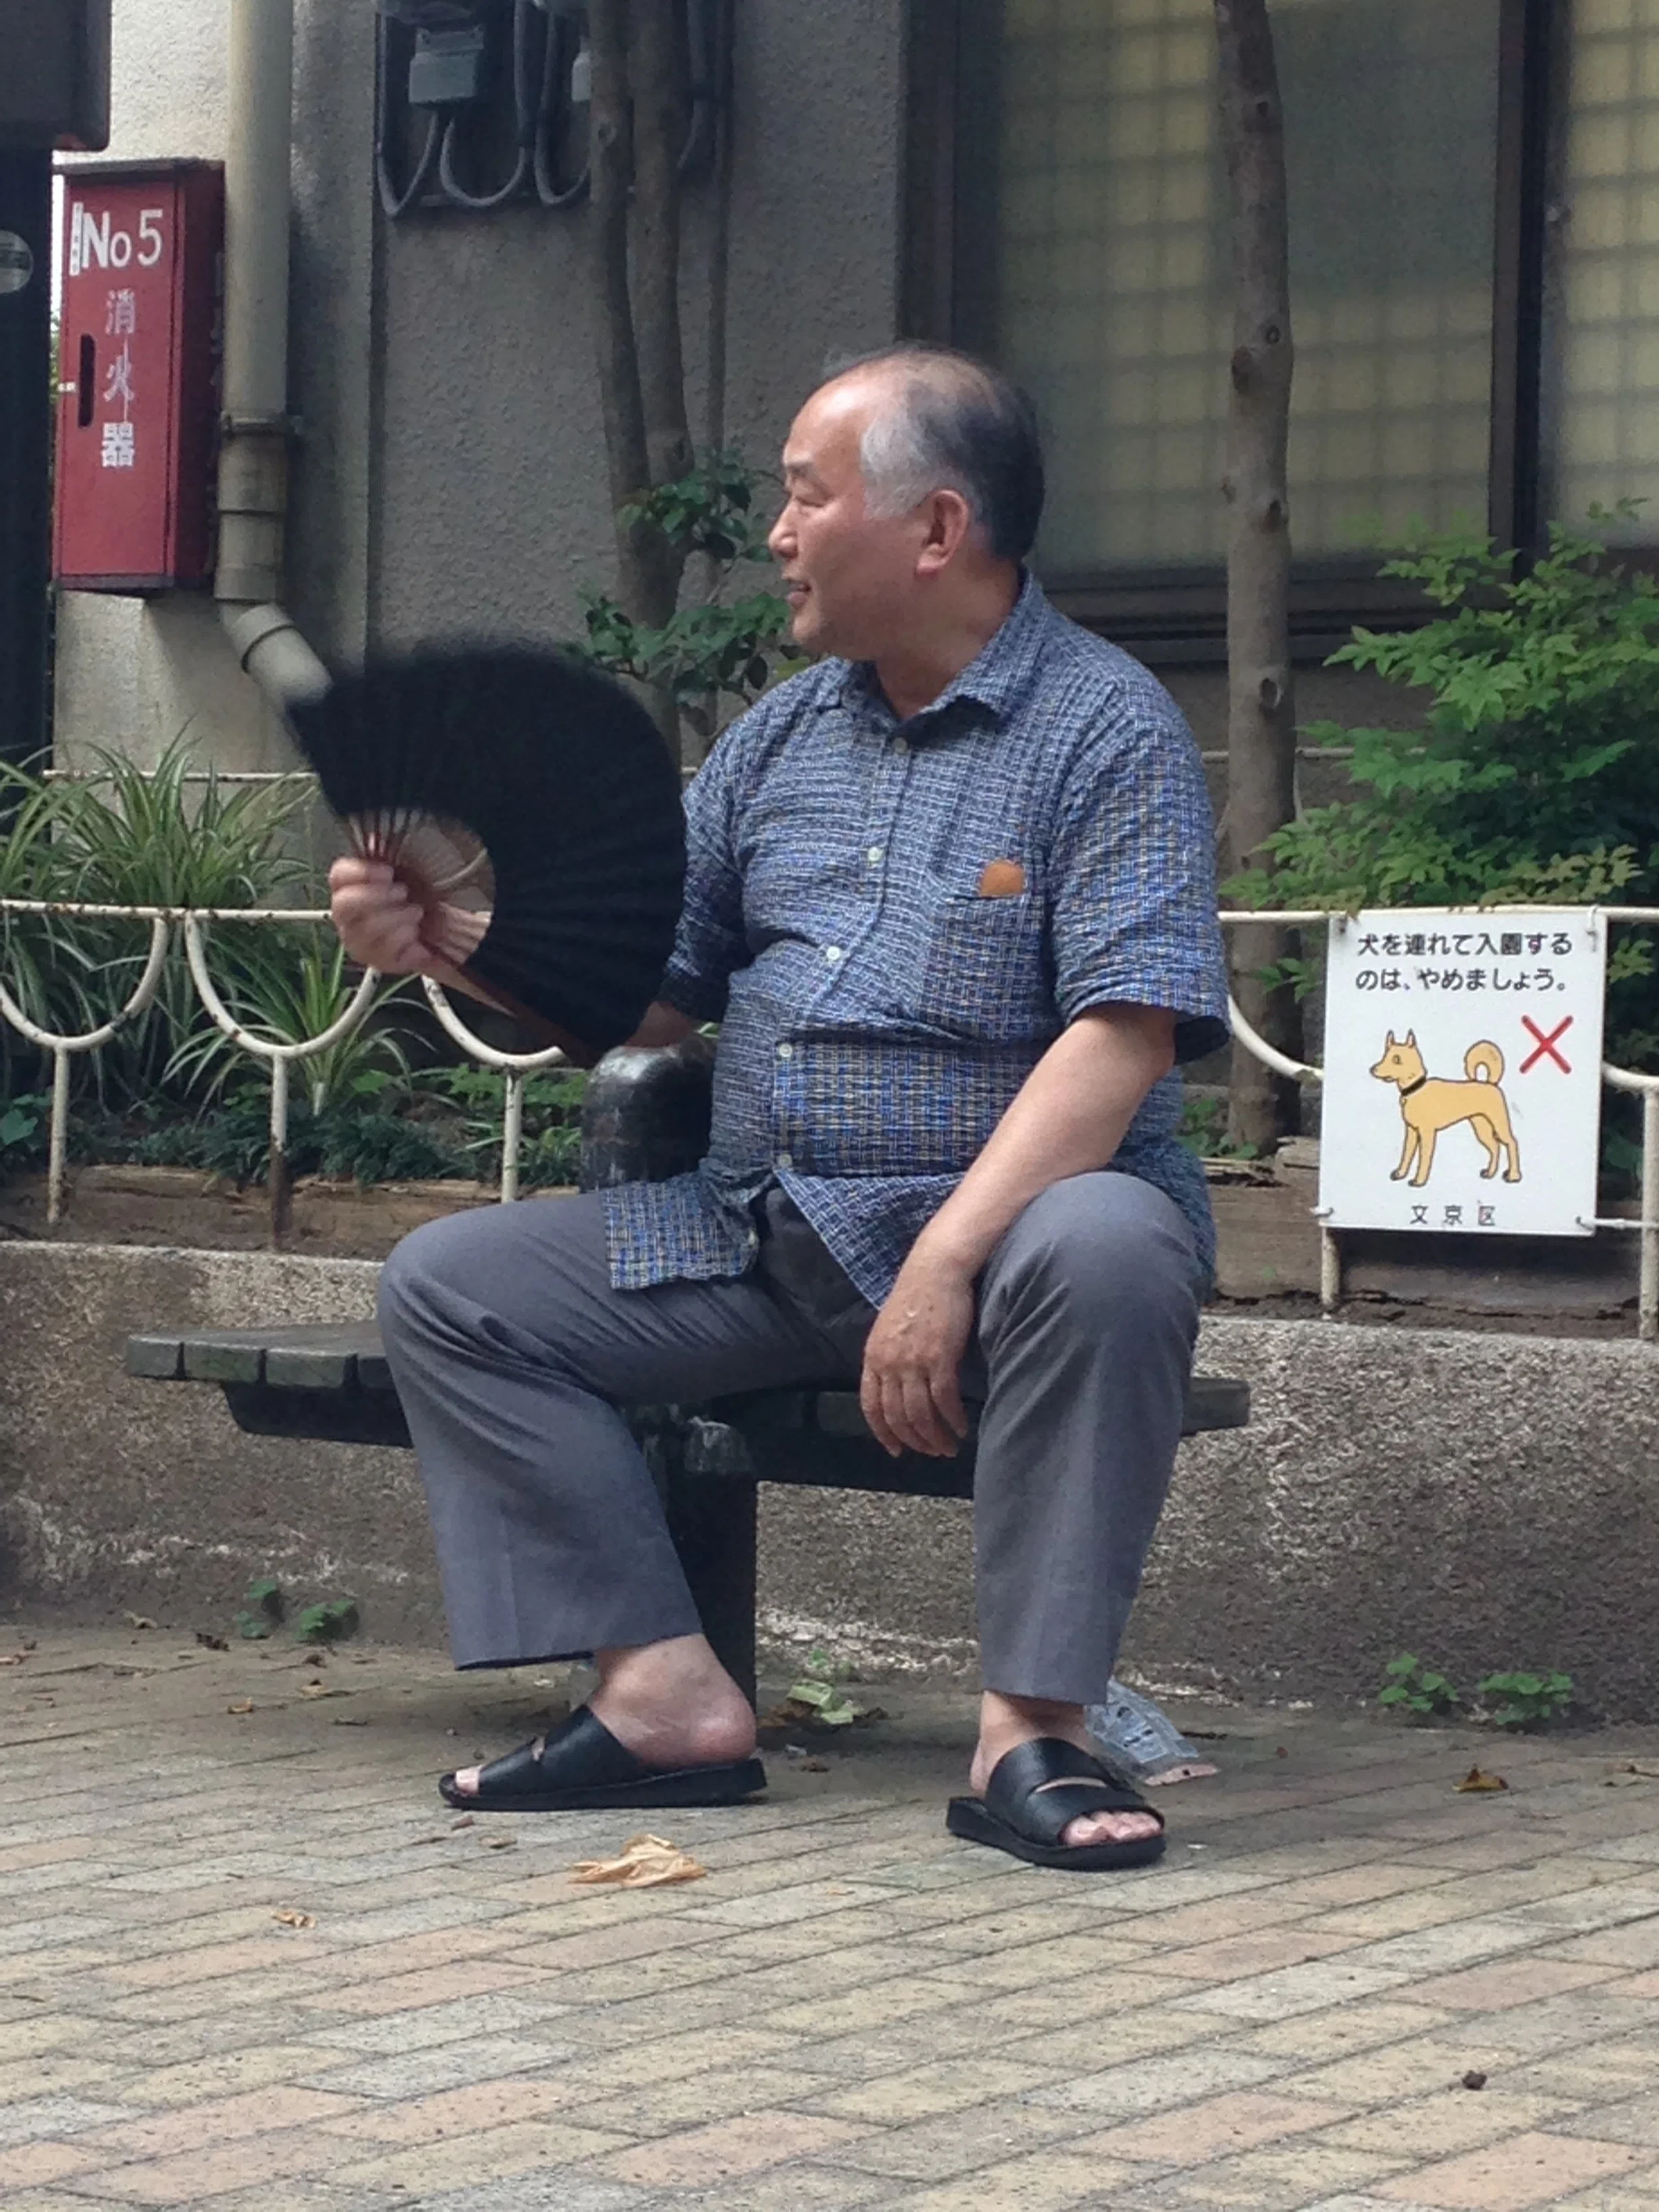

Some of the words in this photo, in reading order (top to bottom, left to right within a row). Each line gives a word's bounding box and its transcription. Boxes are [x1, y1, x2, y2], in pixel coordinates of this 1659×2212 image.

[82, 211, 132, 268] No
[138, 209, 163, 266] 5
[103, 288, 135, 468] 消火器
[1357, 933, 1572, 956] 犬を連れて入園する
[1355, 967, 1565, 991] のは、やめましょう。
[1410, 1205, 1495, 1226] 文京区
